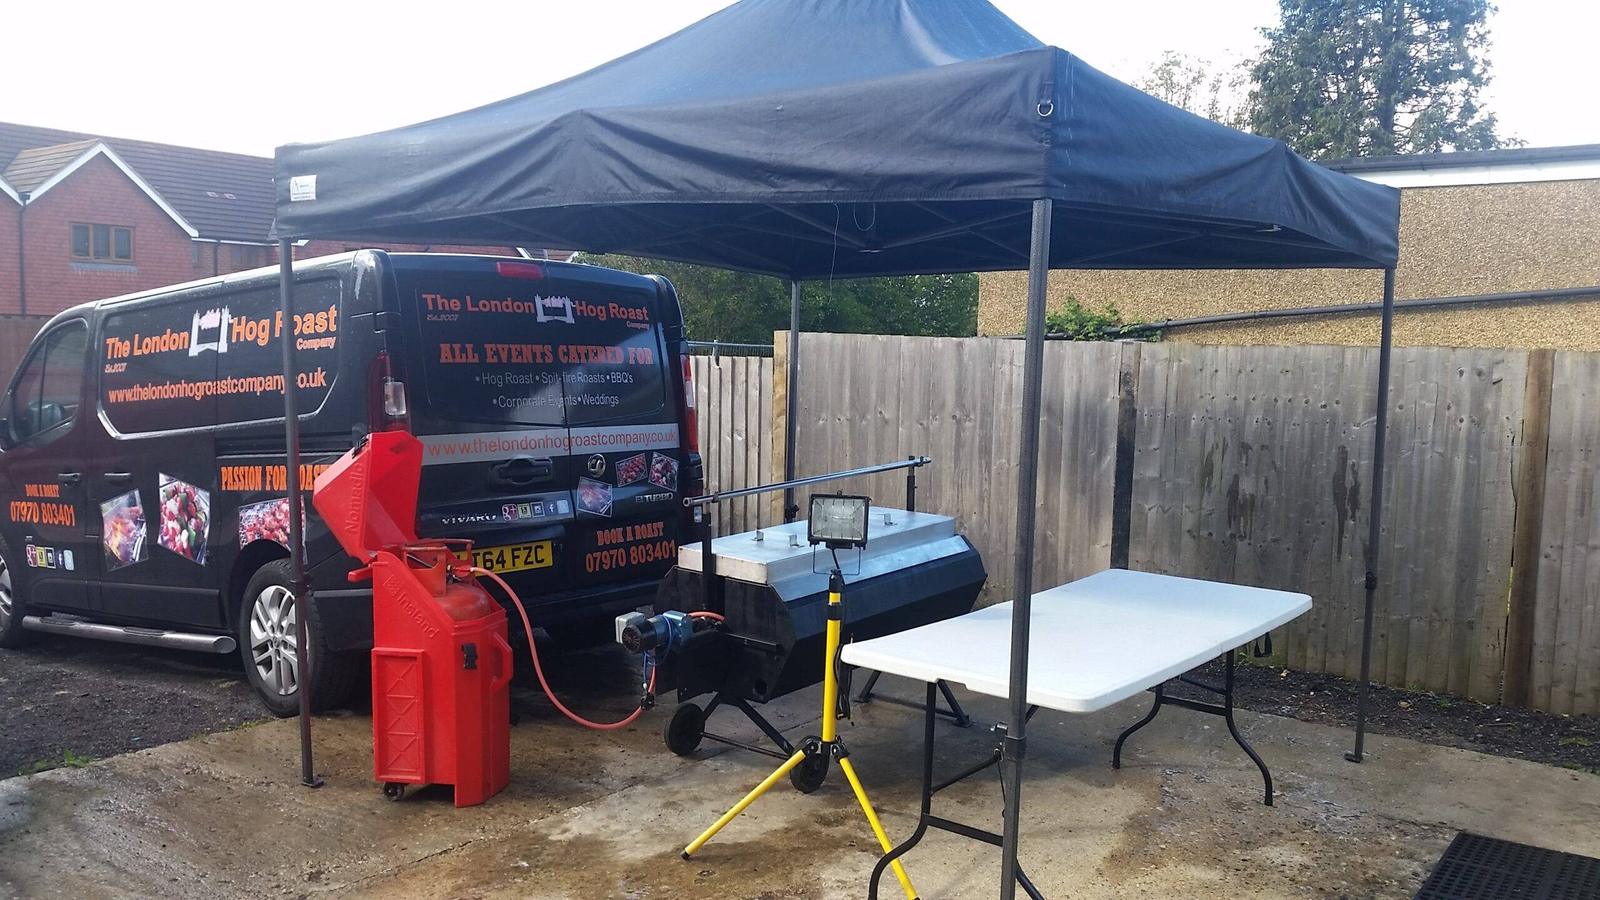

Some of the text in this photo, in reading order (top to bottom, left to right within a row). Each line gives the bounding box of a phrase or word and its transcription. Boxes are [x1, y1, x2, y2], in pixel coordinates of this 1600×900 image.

[422, 294, 648, 320] The London Hog Roast
[106, 337, 130, 359] The
[133, 329, 189, 356] London
[231, 316, 270, 346] Hog
[296, 336, 336, 350] Company
[440, 344, 653, 364] ALL EVENTS CATERED FOR
[482, 372, 503, 387] Hog
[505, 372, 533, 384] Roast
[577, 371, 606, 384] Roasts
[611, 371, 633, 384] BBQ's
[581, 393, 619, 407] Weddings
[221, 465, 262, 491] PASSION
[266, 465, 287, 490] FOR
[11, 501, 75, 527] 07970 803401
[597, 522, 664, 545] BOOK A ROAST
[512, 545, 545, 567] FZC
[585, 540, 676, 573] 07970 803401
